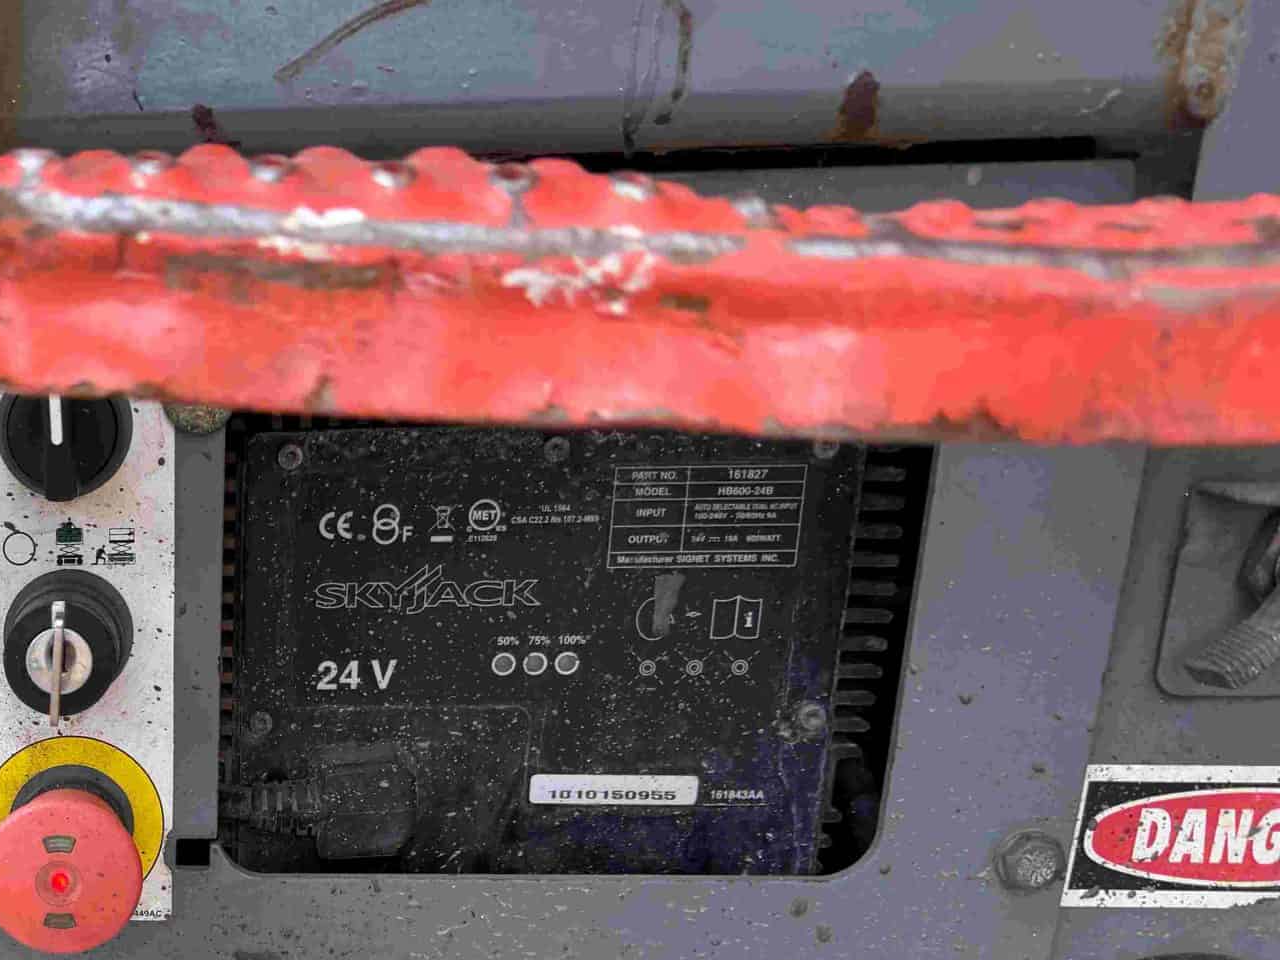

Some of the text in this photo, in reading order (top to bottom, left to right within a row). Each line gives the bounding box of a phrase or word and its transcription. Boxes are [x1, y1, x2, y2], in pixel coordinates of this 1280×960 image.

[631, 471, 658, 480] PART
[728, 469, 769, 480] 161827
[634, 487, 672, 496] MODEL
[472, 509, 498, 521] MET
[636, 507, 667, 517] INPUT
[713, 554, 758, 563] SYSTEMS
[315, 564, 541, 614] SKYJACK
[497, 635, 587, 646] 50% 75% 100%
[317, 659, 398, 690] 24 V
